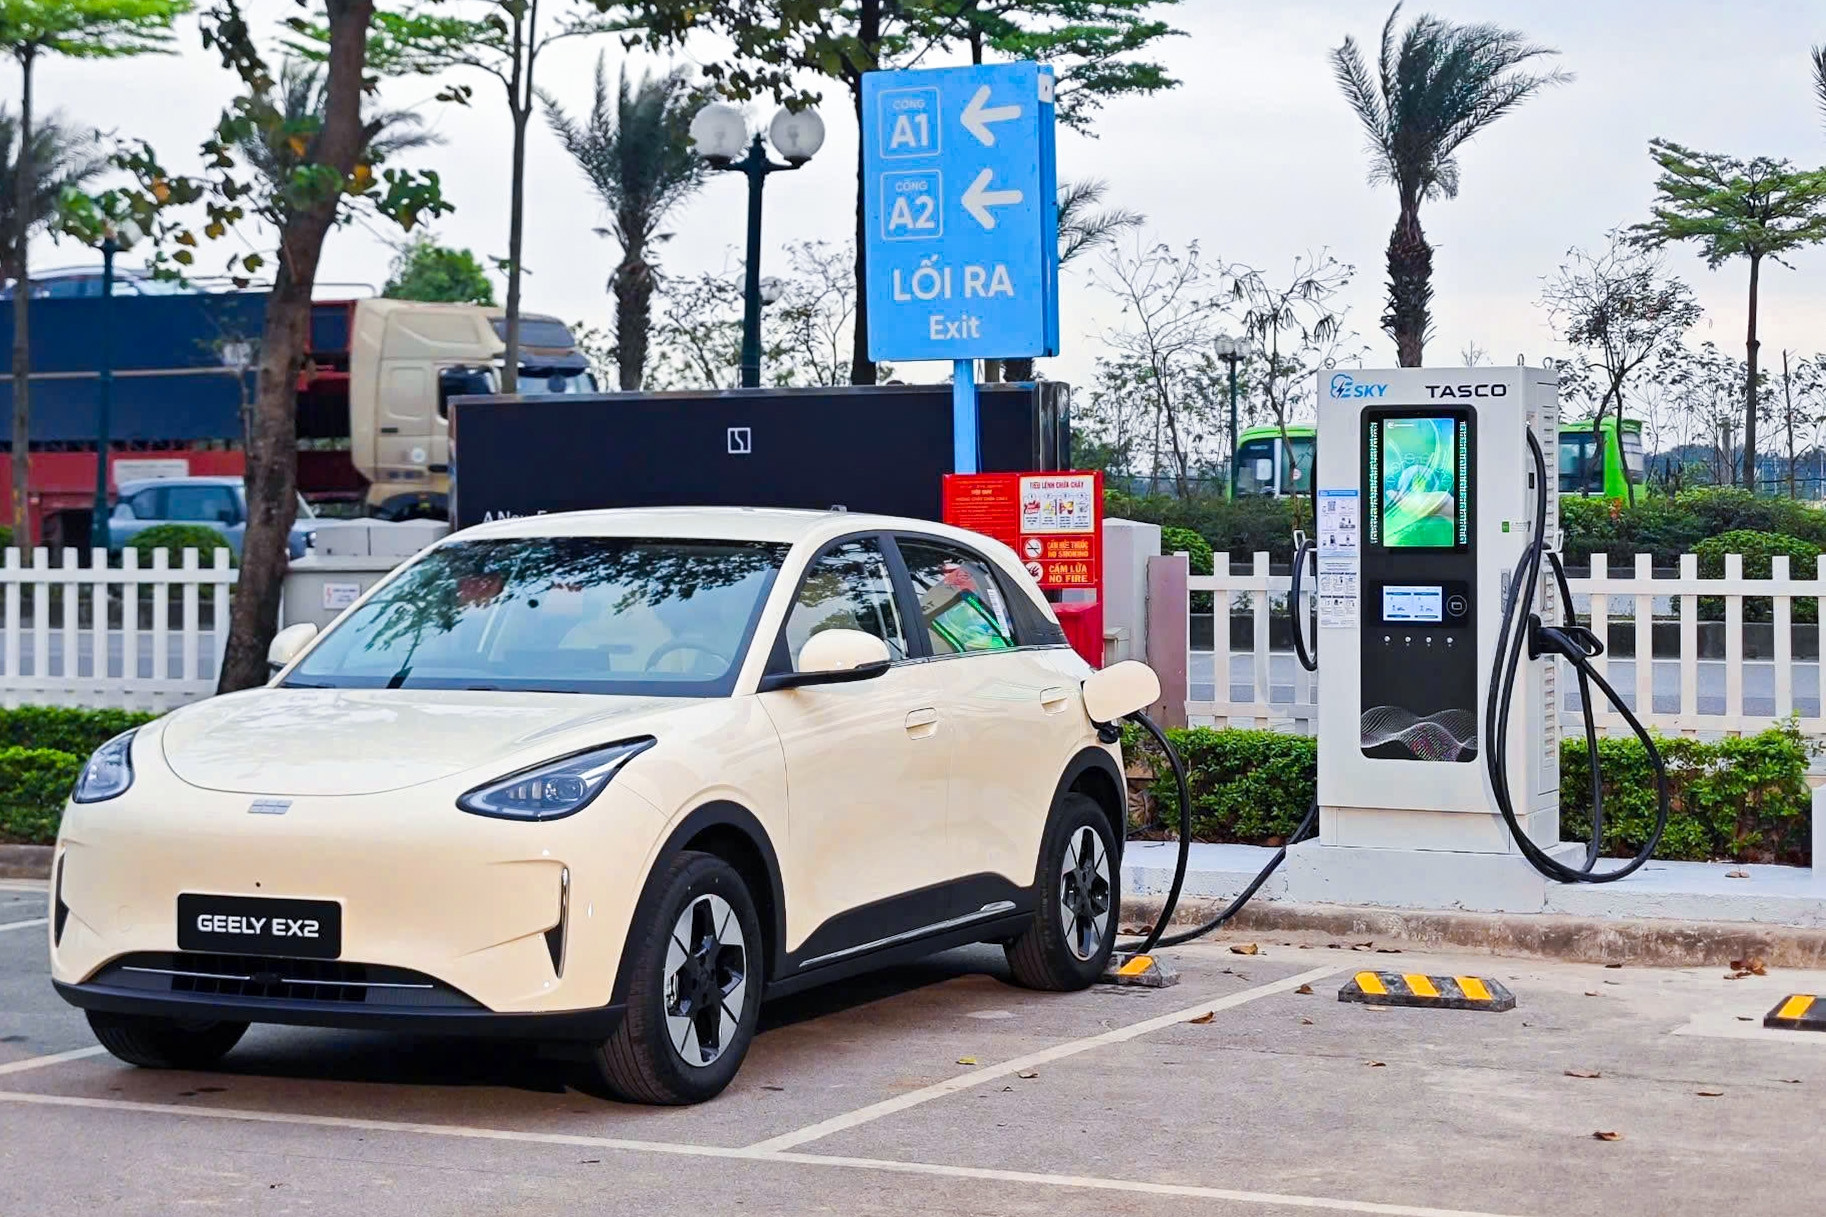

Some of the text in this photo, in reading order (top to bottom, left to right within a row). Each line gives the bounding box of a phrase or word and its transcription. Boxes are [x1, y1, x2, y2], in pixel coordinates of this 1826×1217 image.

[890, 113, 929, 148] A1
[889, 195, 935, 230] A2
[893, 254, 1014, 301] LỐI RA
[930, 313, 981, 341] Exit
[1425, 384, 1507, 398] TASCO
[1048, 574, 1088, 583] NO FIRE
[197, 914, 320, 938] GEELY EX2
